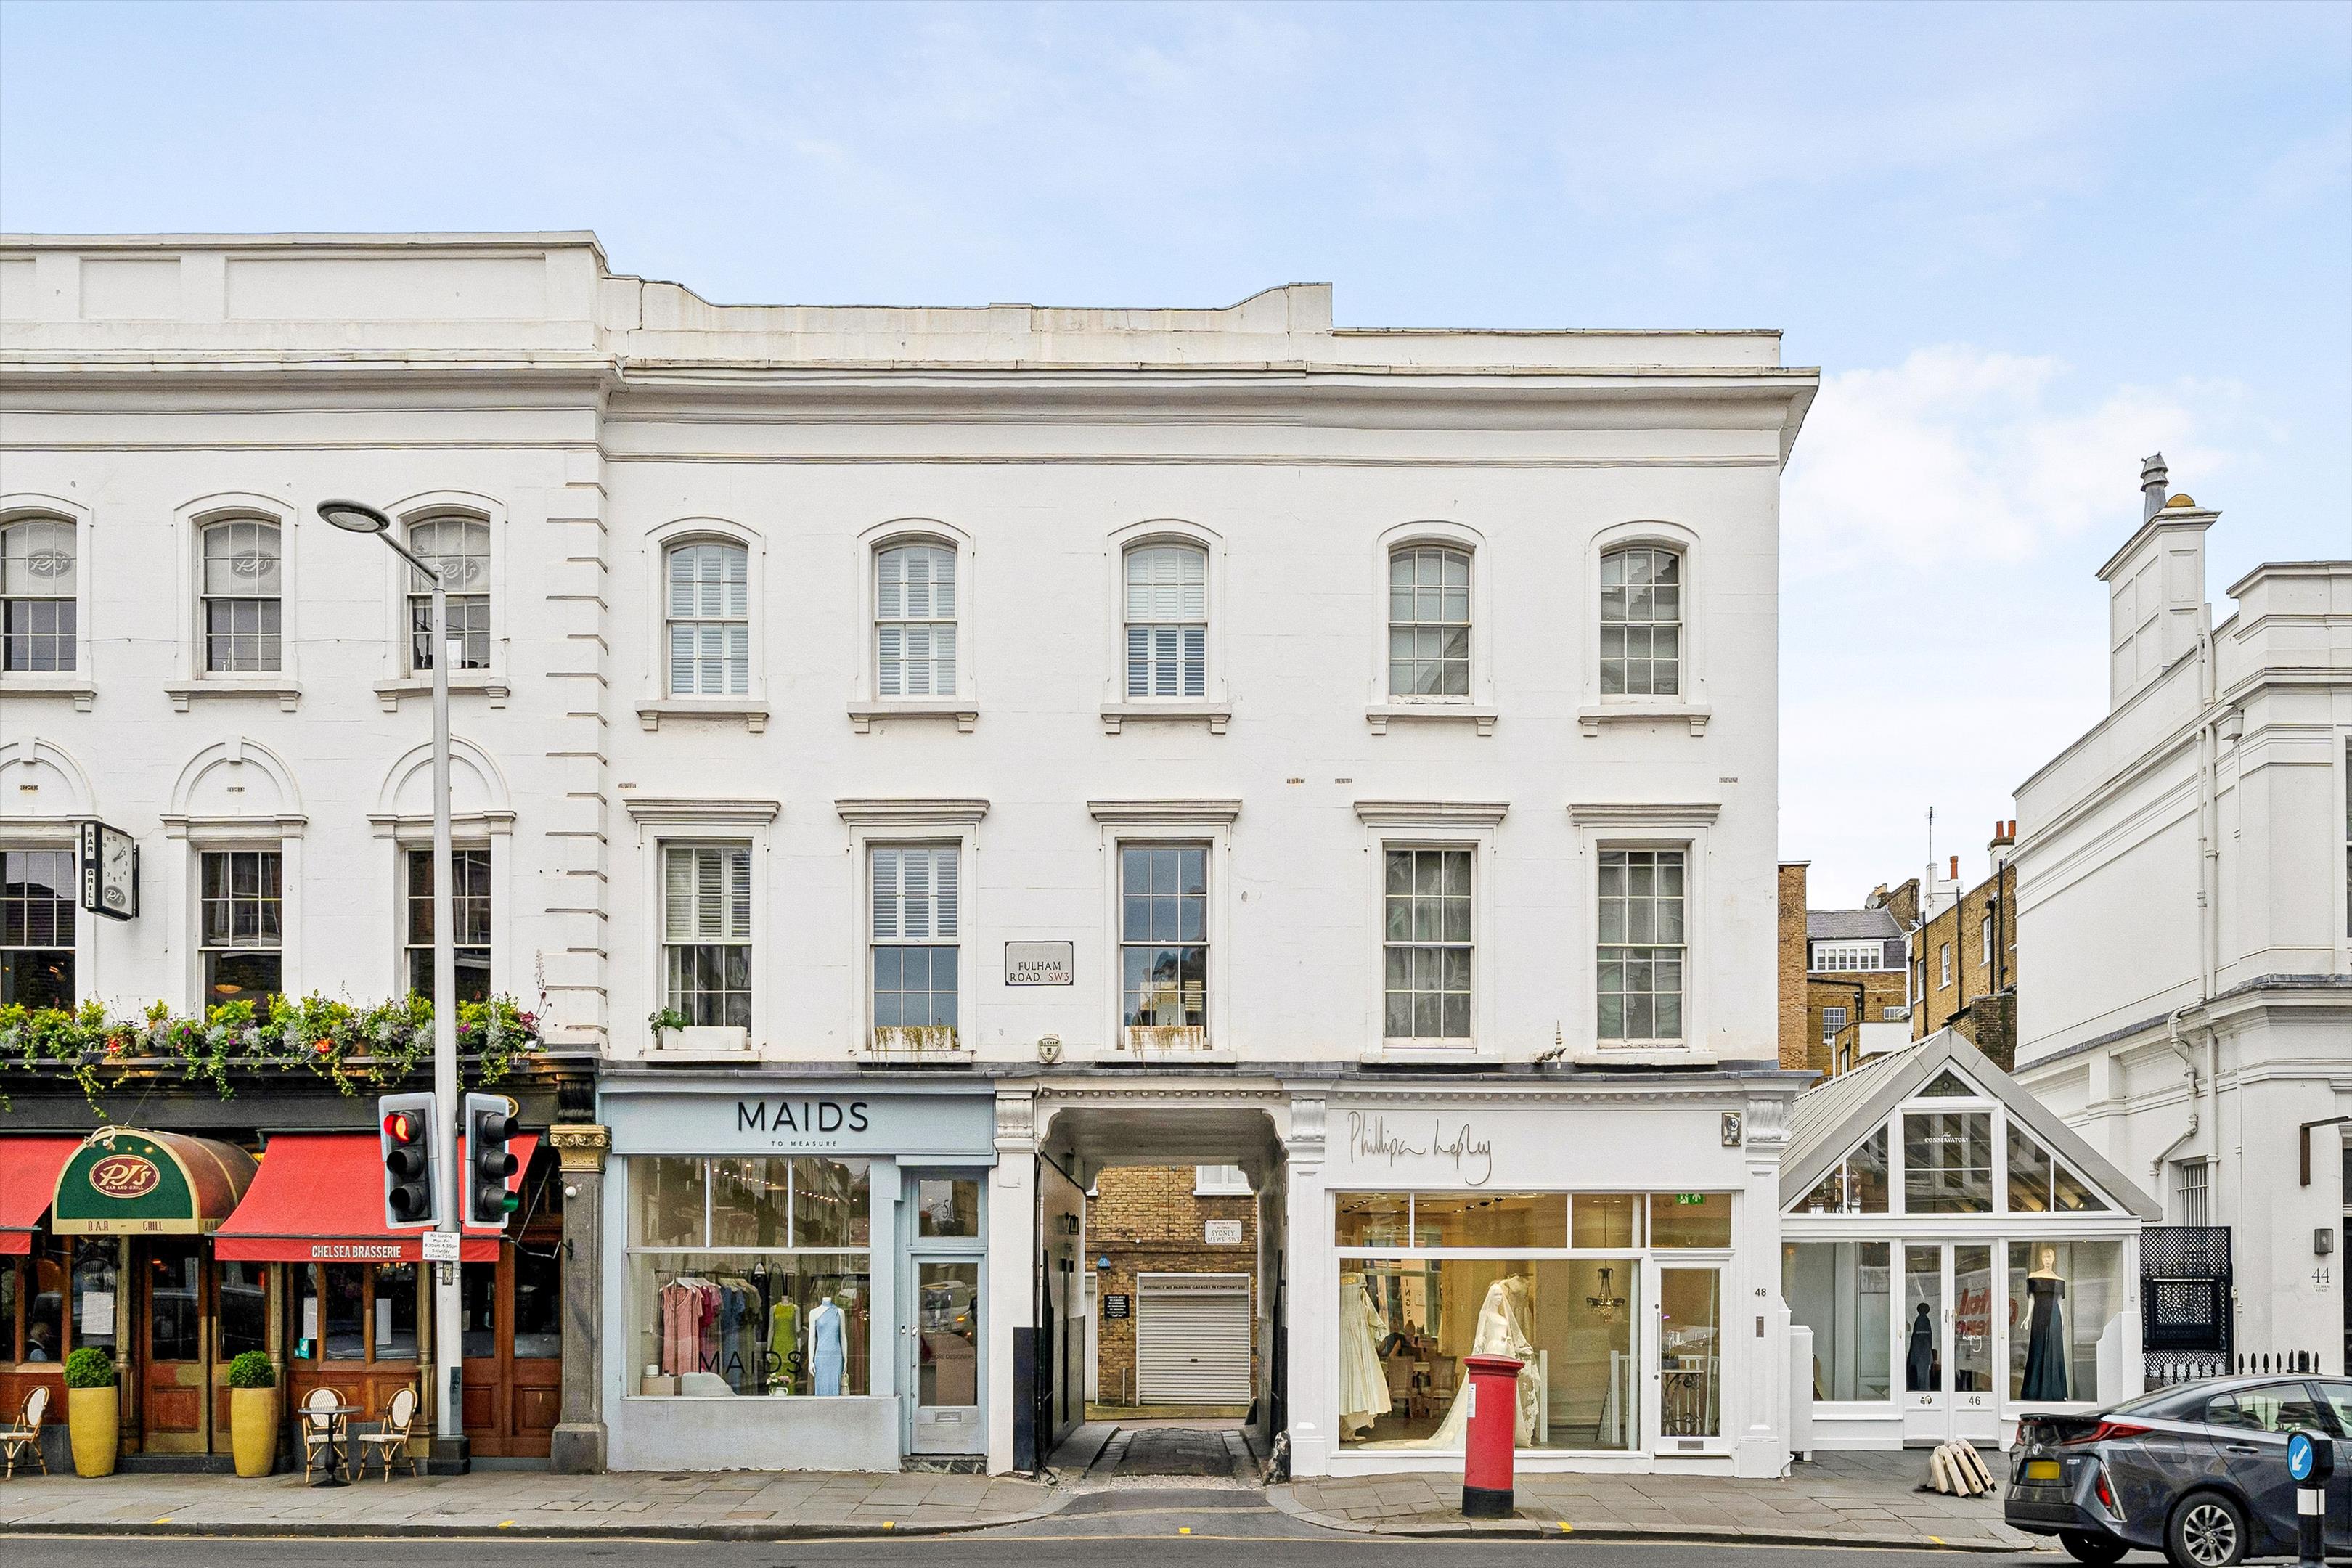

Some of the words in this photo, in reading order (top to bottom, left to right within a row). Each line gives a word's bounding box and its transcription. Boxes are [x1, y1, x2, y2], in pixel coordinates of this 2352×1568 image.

[1018, 961, 1061, 971] FULHAM
[1010, 973, 1040, 981] ROAD
[1048, 972, 1069, 981] SW3
[738, 1101, 868, 1132] MAIDS
[1348, 1111, 1426, 1167] Phillipa
[99, 1162, 152, 1186] PJ's
[88, 1220, 109, 1232] BAR
[142, 1220, 163, 1232] GRILL
[311, 1245, 351, 1257] CHELSEA
[352, 1246, 401, 1258] BRASSERIE
[2311, 1267, 2330, 1283] 44
[1755, 1288, 1767, 1297] 48
[698, 1350, 803, 1374] MAIDS
[1969, 1395, 1981, 1405] 46
